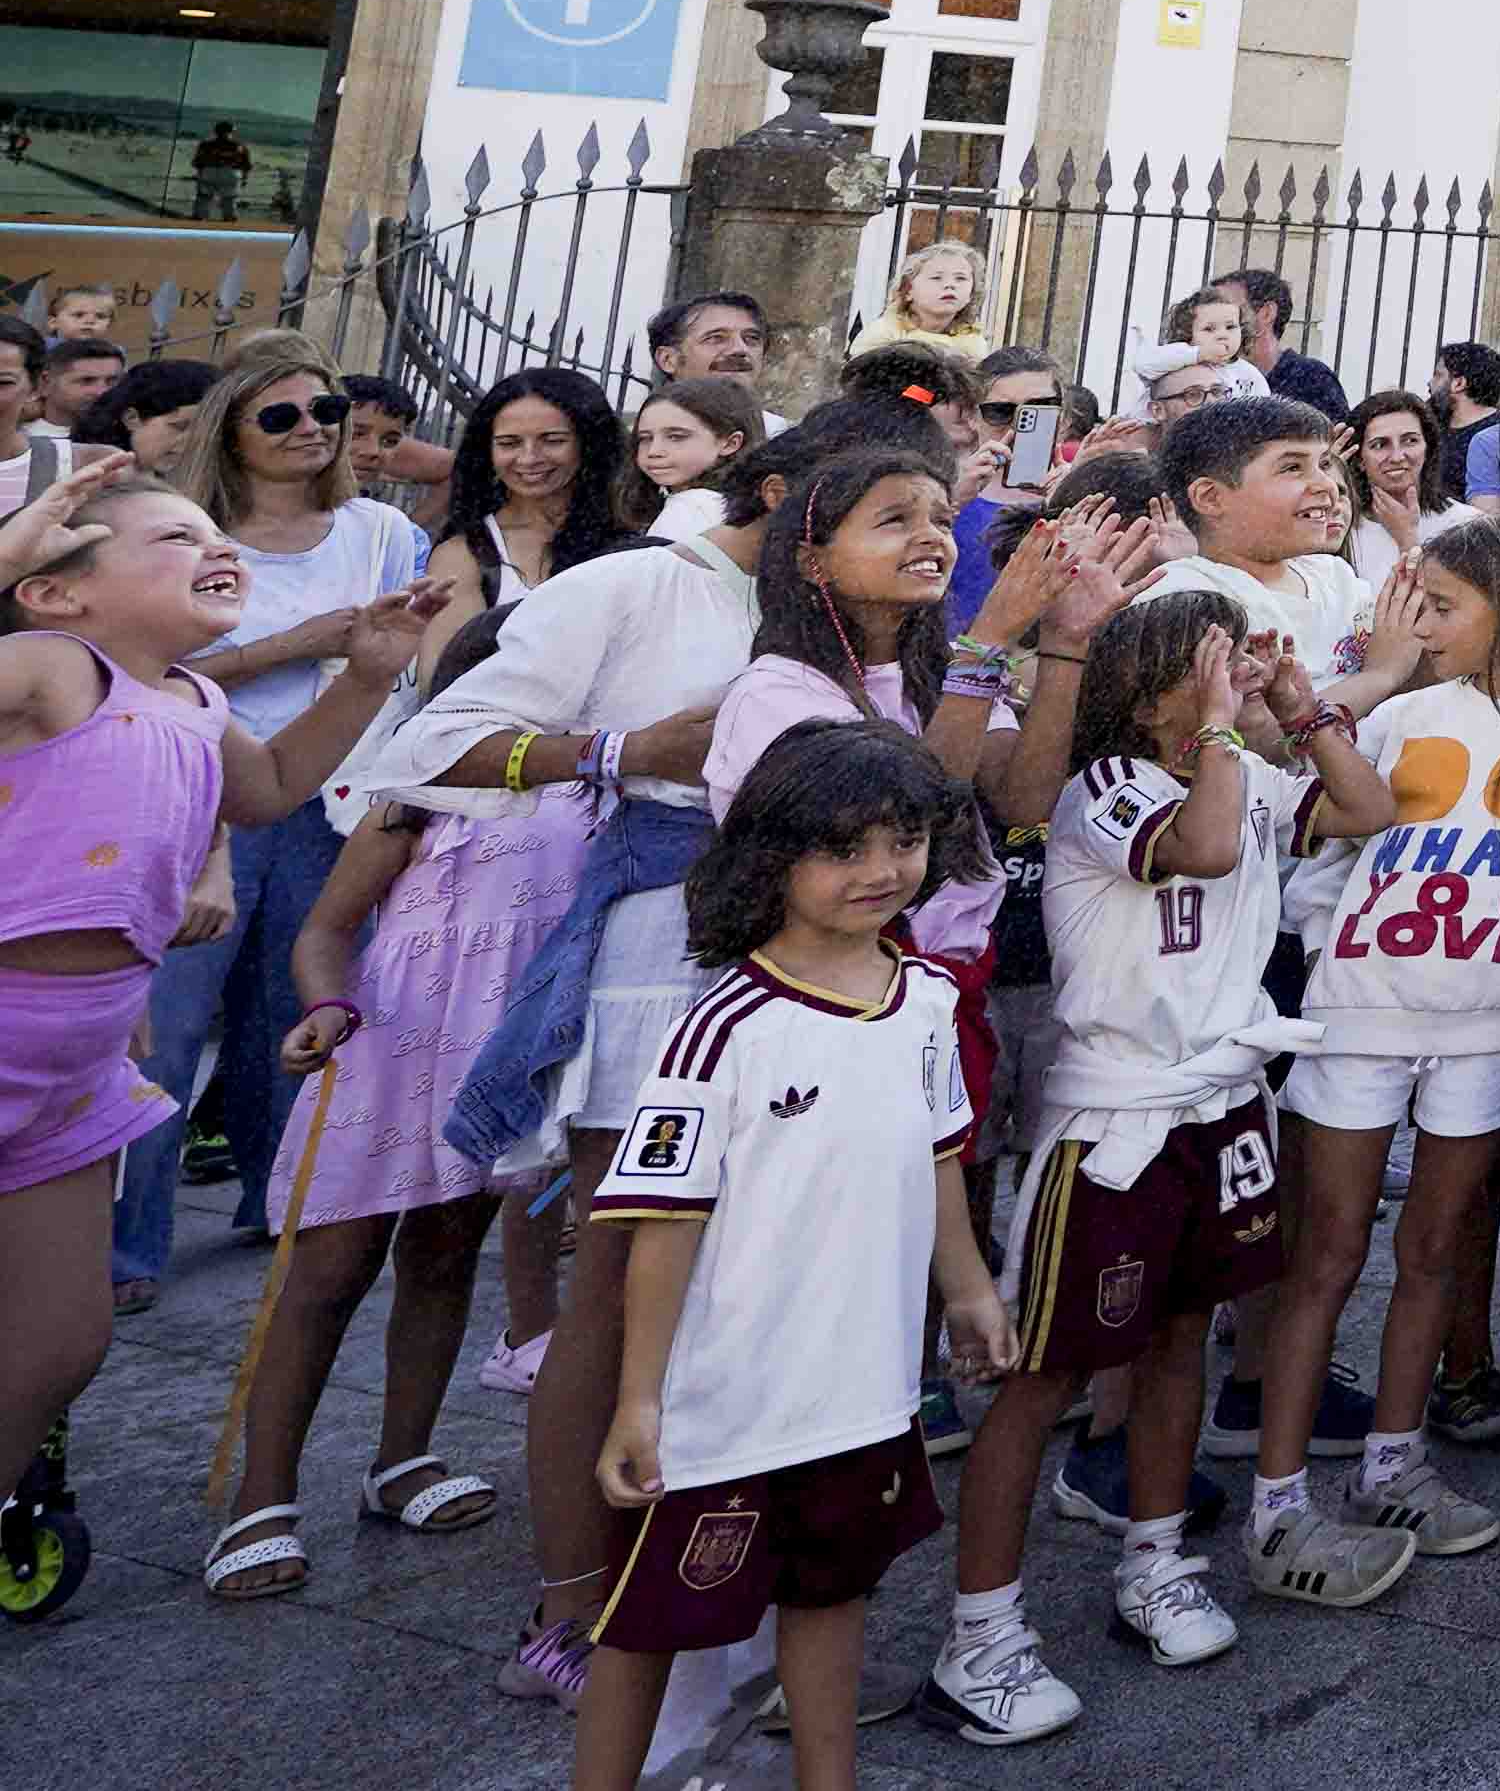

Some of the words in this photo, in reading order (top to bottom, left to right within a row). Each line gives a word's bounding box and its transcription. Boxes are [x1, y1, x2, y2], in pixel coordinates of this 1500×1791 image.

[472, 832, 551, 865] Barbie
[1003, 856, 1046, 890] Sp
[1154, 887, 1205, 956] 19
[1218, 1129, 1276, 1215] 19
